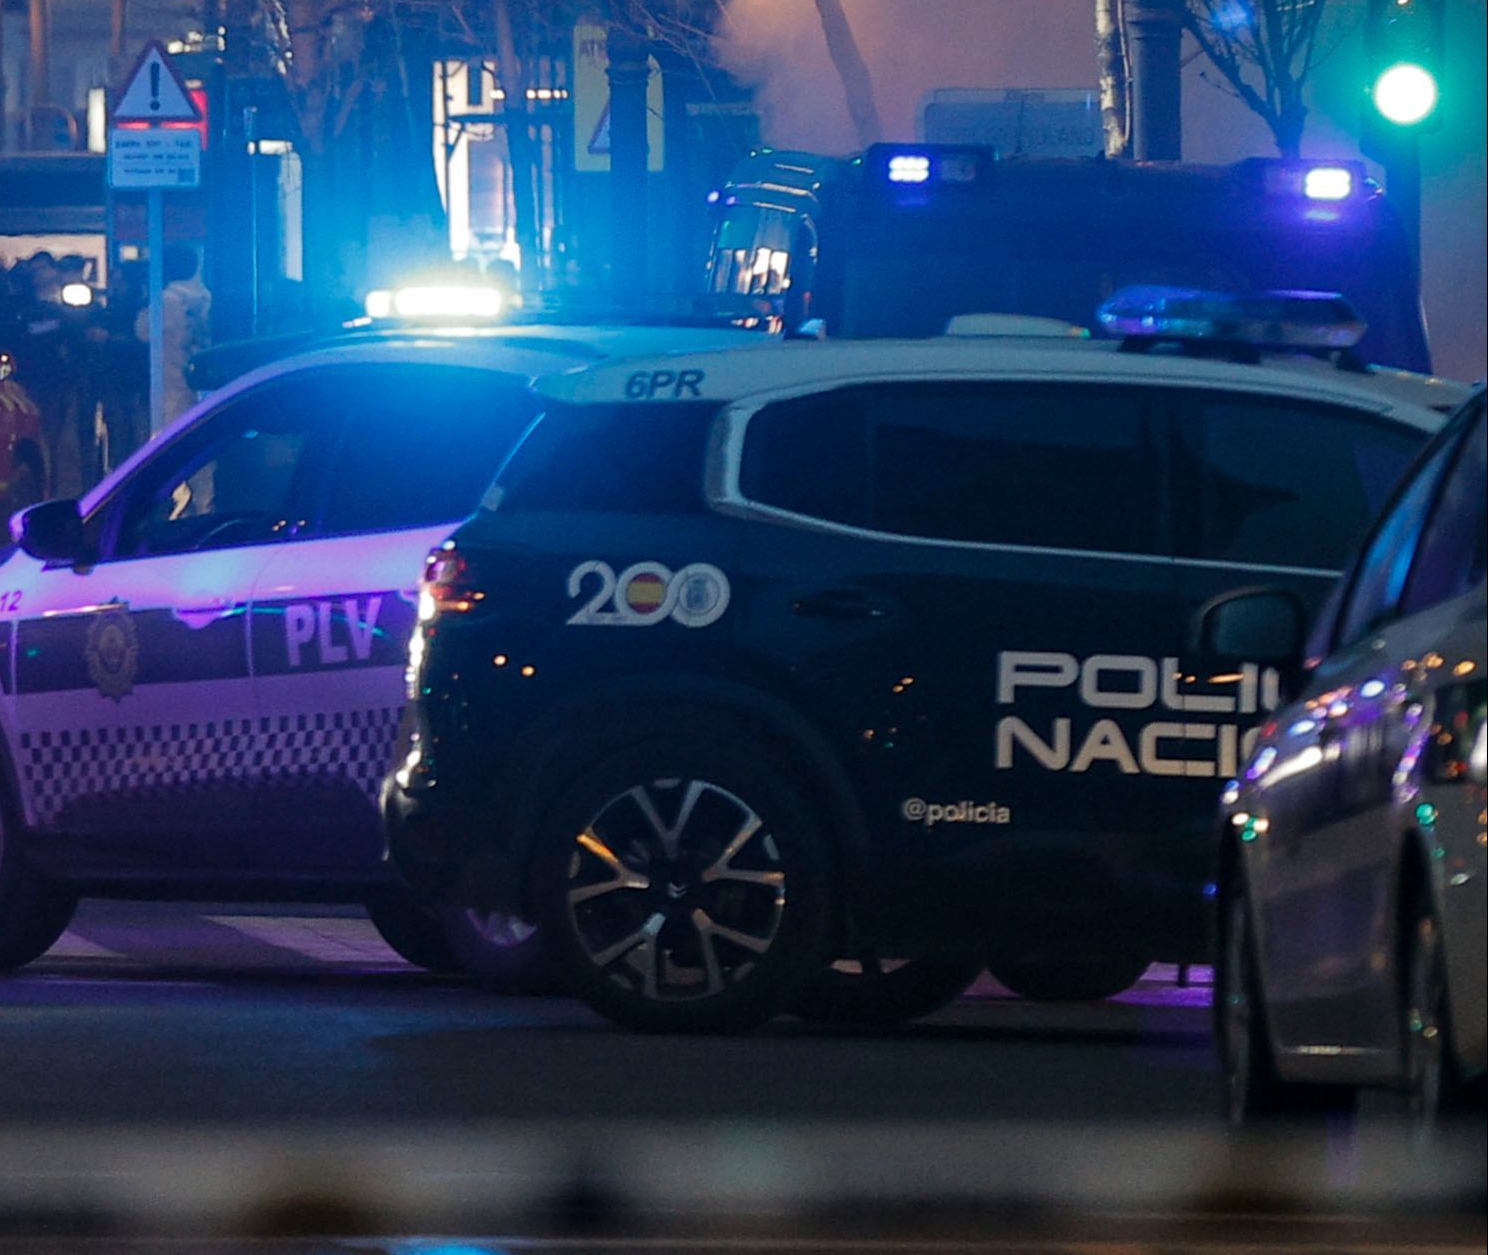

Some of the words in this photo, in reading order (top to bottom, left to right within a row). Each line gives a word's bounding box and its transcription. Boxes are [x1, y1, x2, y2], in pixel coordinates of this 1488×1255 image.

[625, 369, 706, 399] 6PR
[566, 560, 731, 628] 200
[285, 597, 382, 667] PLV
[902, 798, 1012, 828] @policia
